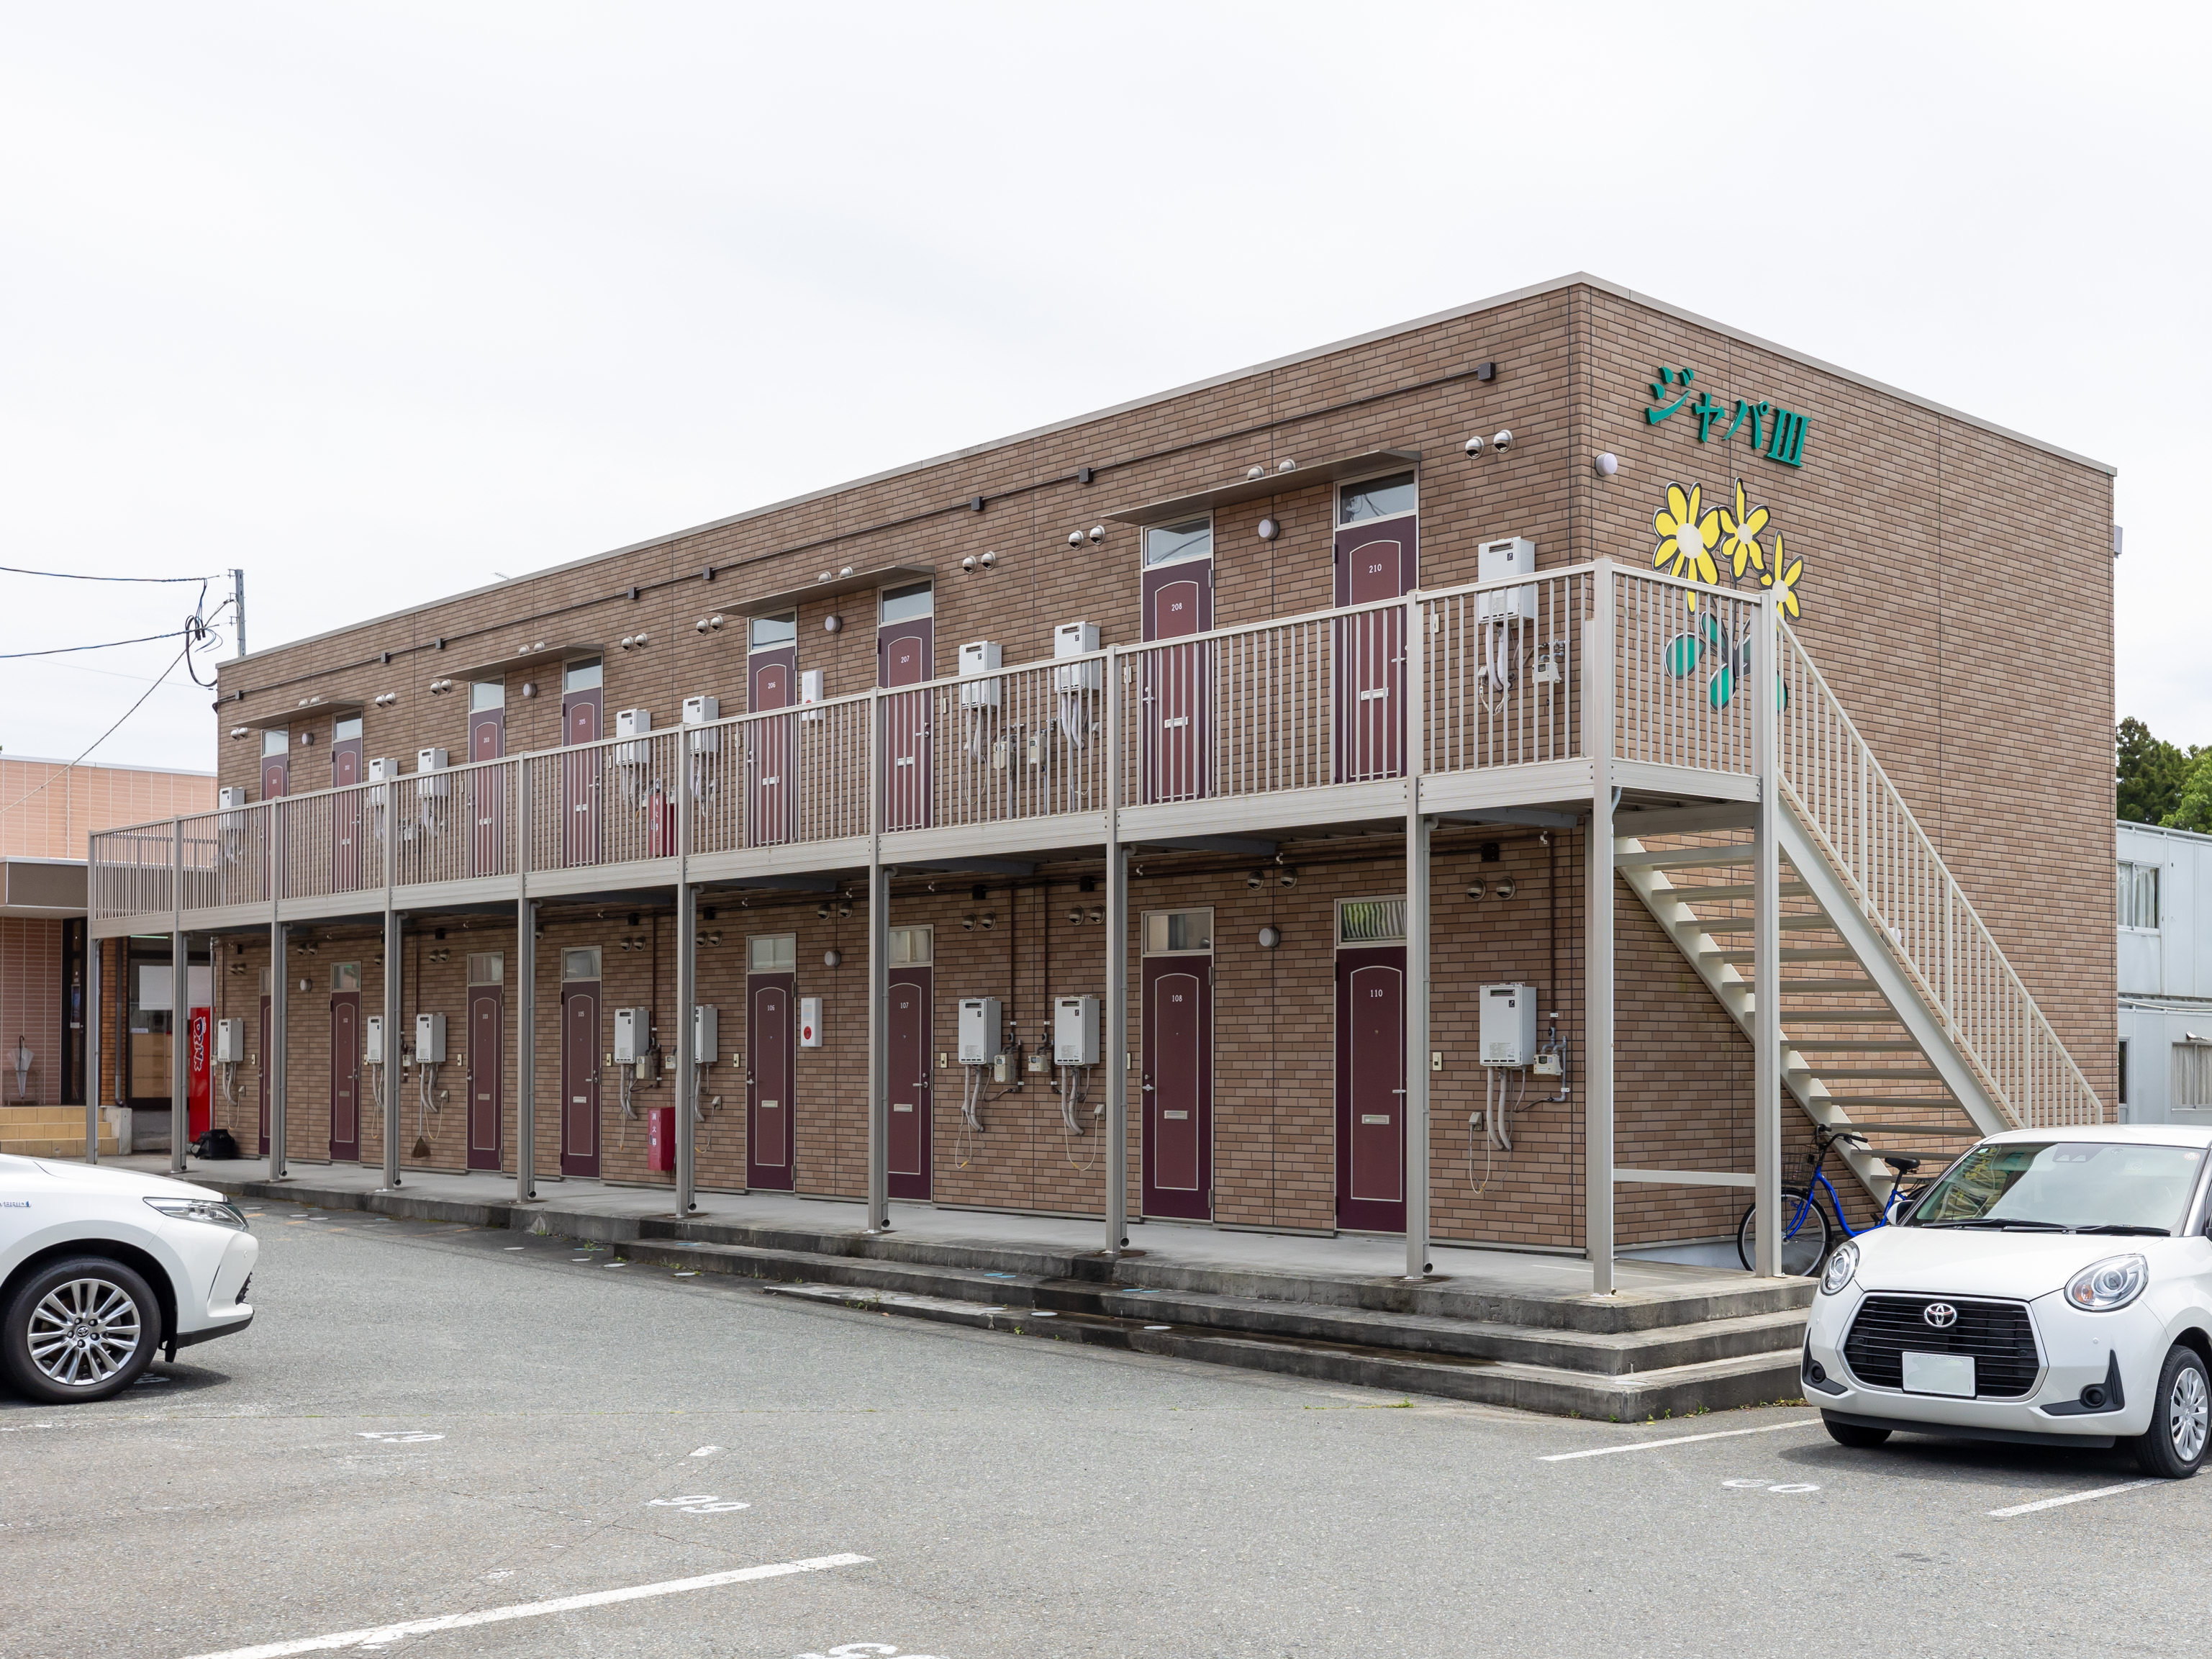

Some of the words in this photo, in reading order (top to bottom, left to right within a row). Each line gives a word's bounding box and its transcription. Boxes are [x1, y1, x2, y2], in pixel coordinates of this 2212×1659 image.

[1369, 564, 1382, 574] 210
[1171, 602, 1182, 612] 208
[900, 655, 910, 664] 207
[1370, 989, 1383, 998] 110
